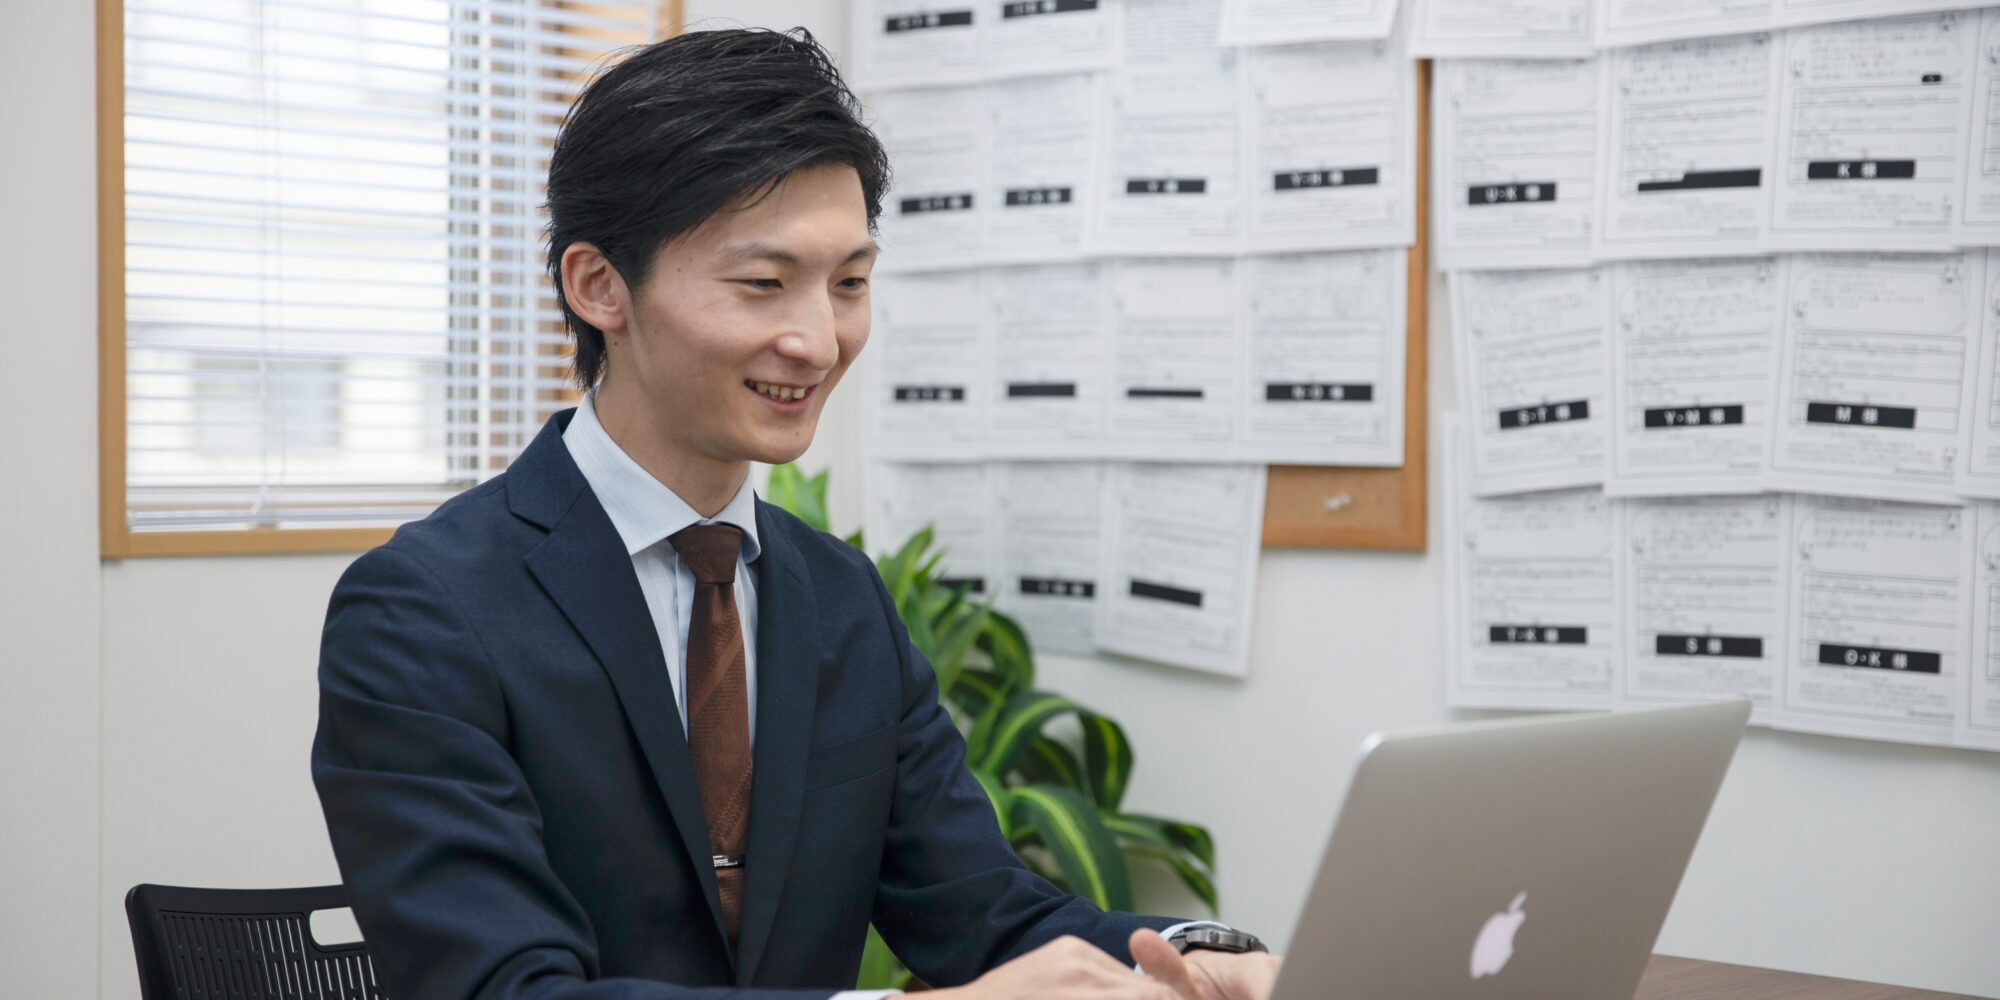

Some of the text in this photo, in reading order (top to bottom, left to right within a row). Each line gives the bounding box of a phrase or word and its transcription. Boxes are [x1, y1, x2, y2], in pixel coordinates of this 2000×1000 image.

[1837, 163, 1850, 179] K
[1835, 406, 1851, 423] M
[1685, 637, 1698, 654] S
